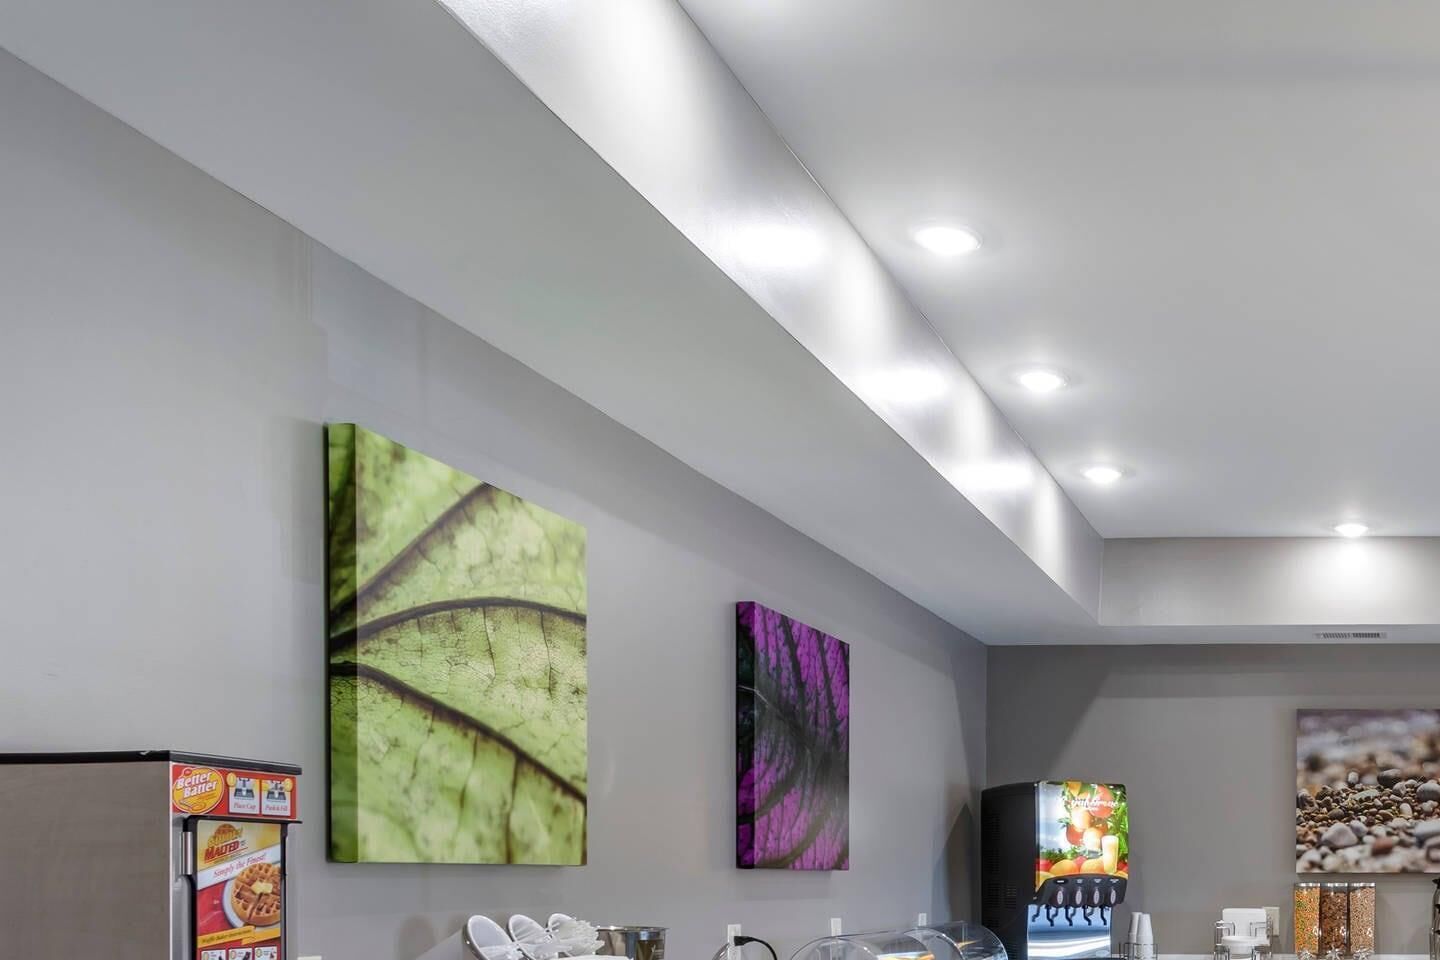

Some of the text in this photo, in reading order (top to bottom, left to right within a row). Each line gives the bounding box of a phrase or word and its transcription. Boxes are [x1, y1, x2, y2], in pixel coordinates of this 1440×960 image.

[176, 772, 212, 790] Better
[183, 780, 218, 798] Batter
[205, 840, 240, 863] MALTED
